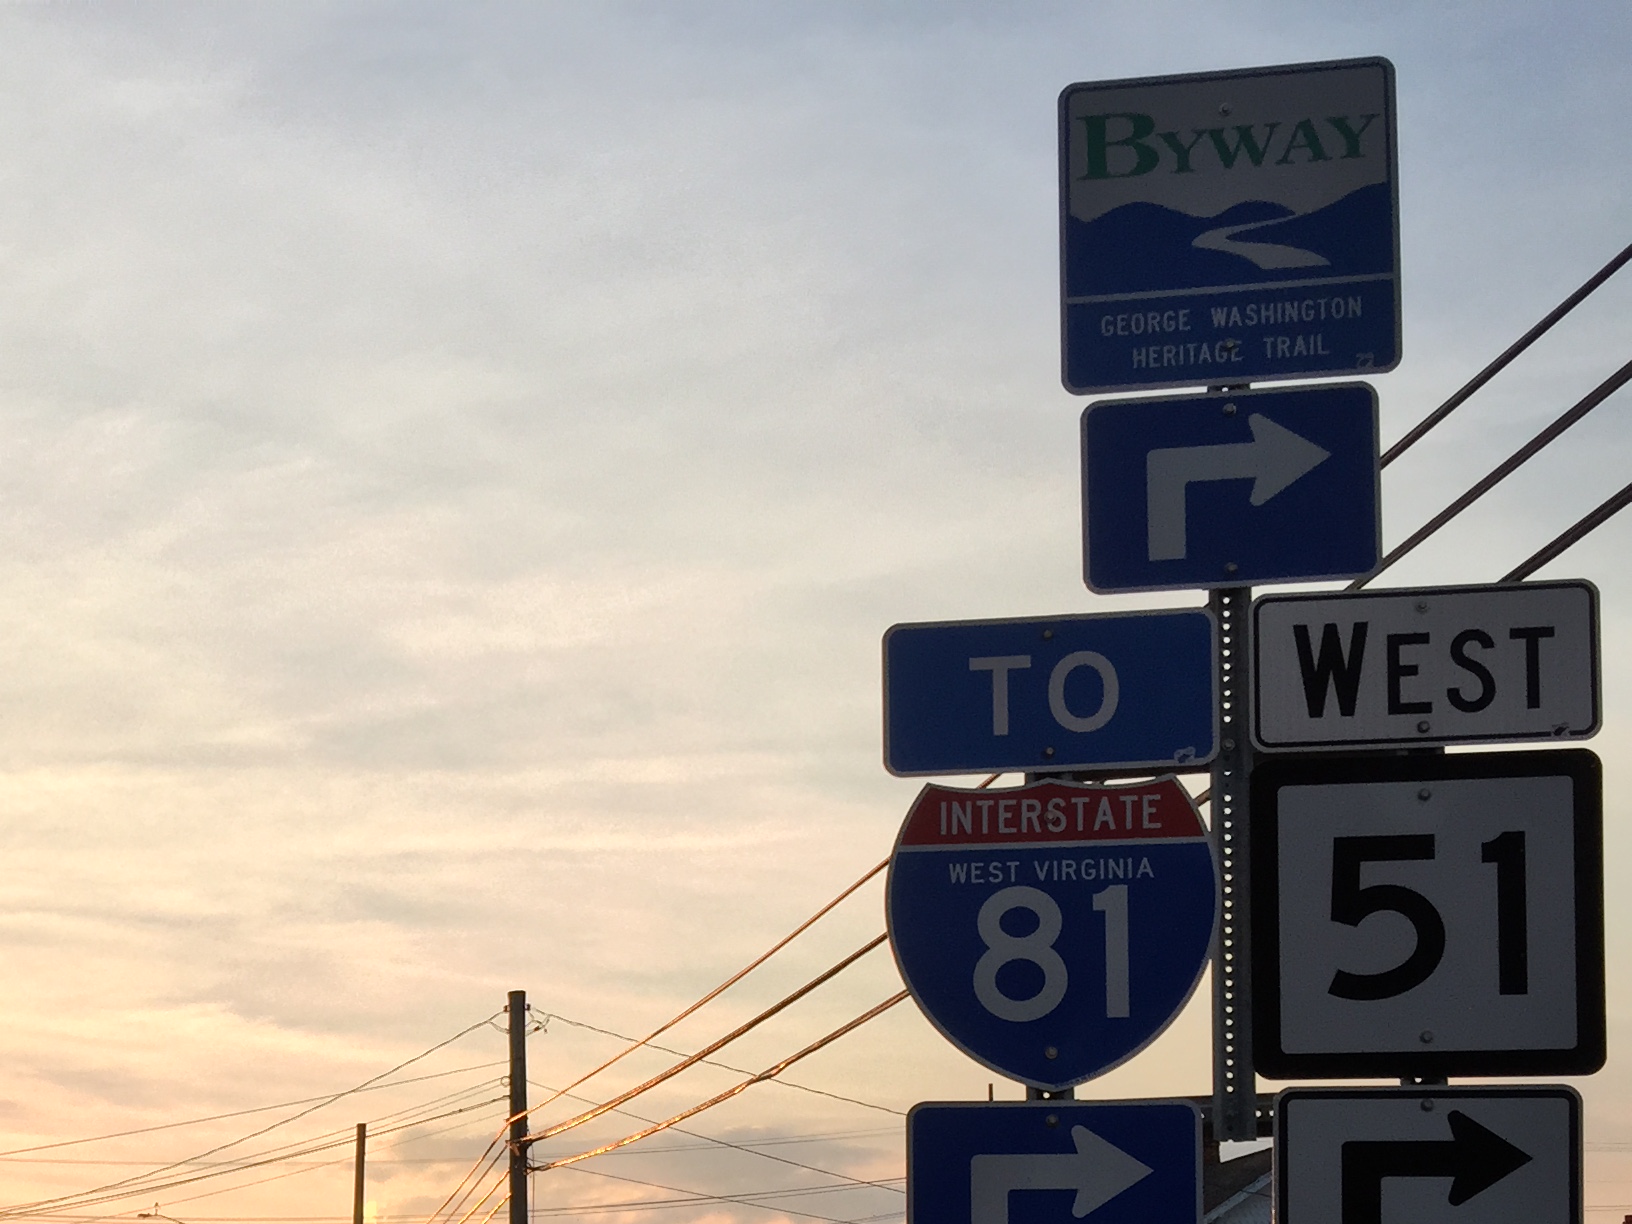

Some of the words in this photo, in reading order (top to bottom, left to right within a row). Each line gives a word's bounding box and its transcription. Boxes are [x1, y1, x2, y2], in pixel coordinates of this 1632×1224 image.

[1076, 112, 1381, 181] BYWAY
[1101, 309, 1192, 337] GEORGE
[1211, 296, 1363, 328] WASHINGTON
[1132, 340, 1244, 369] HERITAGE
[1263, 333, 1330, 359] TRAIL
[968, 650, 1120, 736] TO
[1292, 621, 1556, 719] WEST
[939, 794, 1162, 836] INTERSTATE
[948, 861, 1021, 884] WEST
[1034, 857, 1155, 881] VIRGINIA
[1327, 831, 1528, 1001] 51
[972, 884, 1131, 1022] 81
